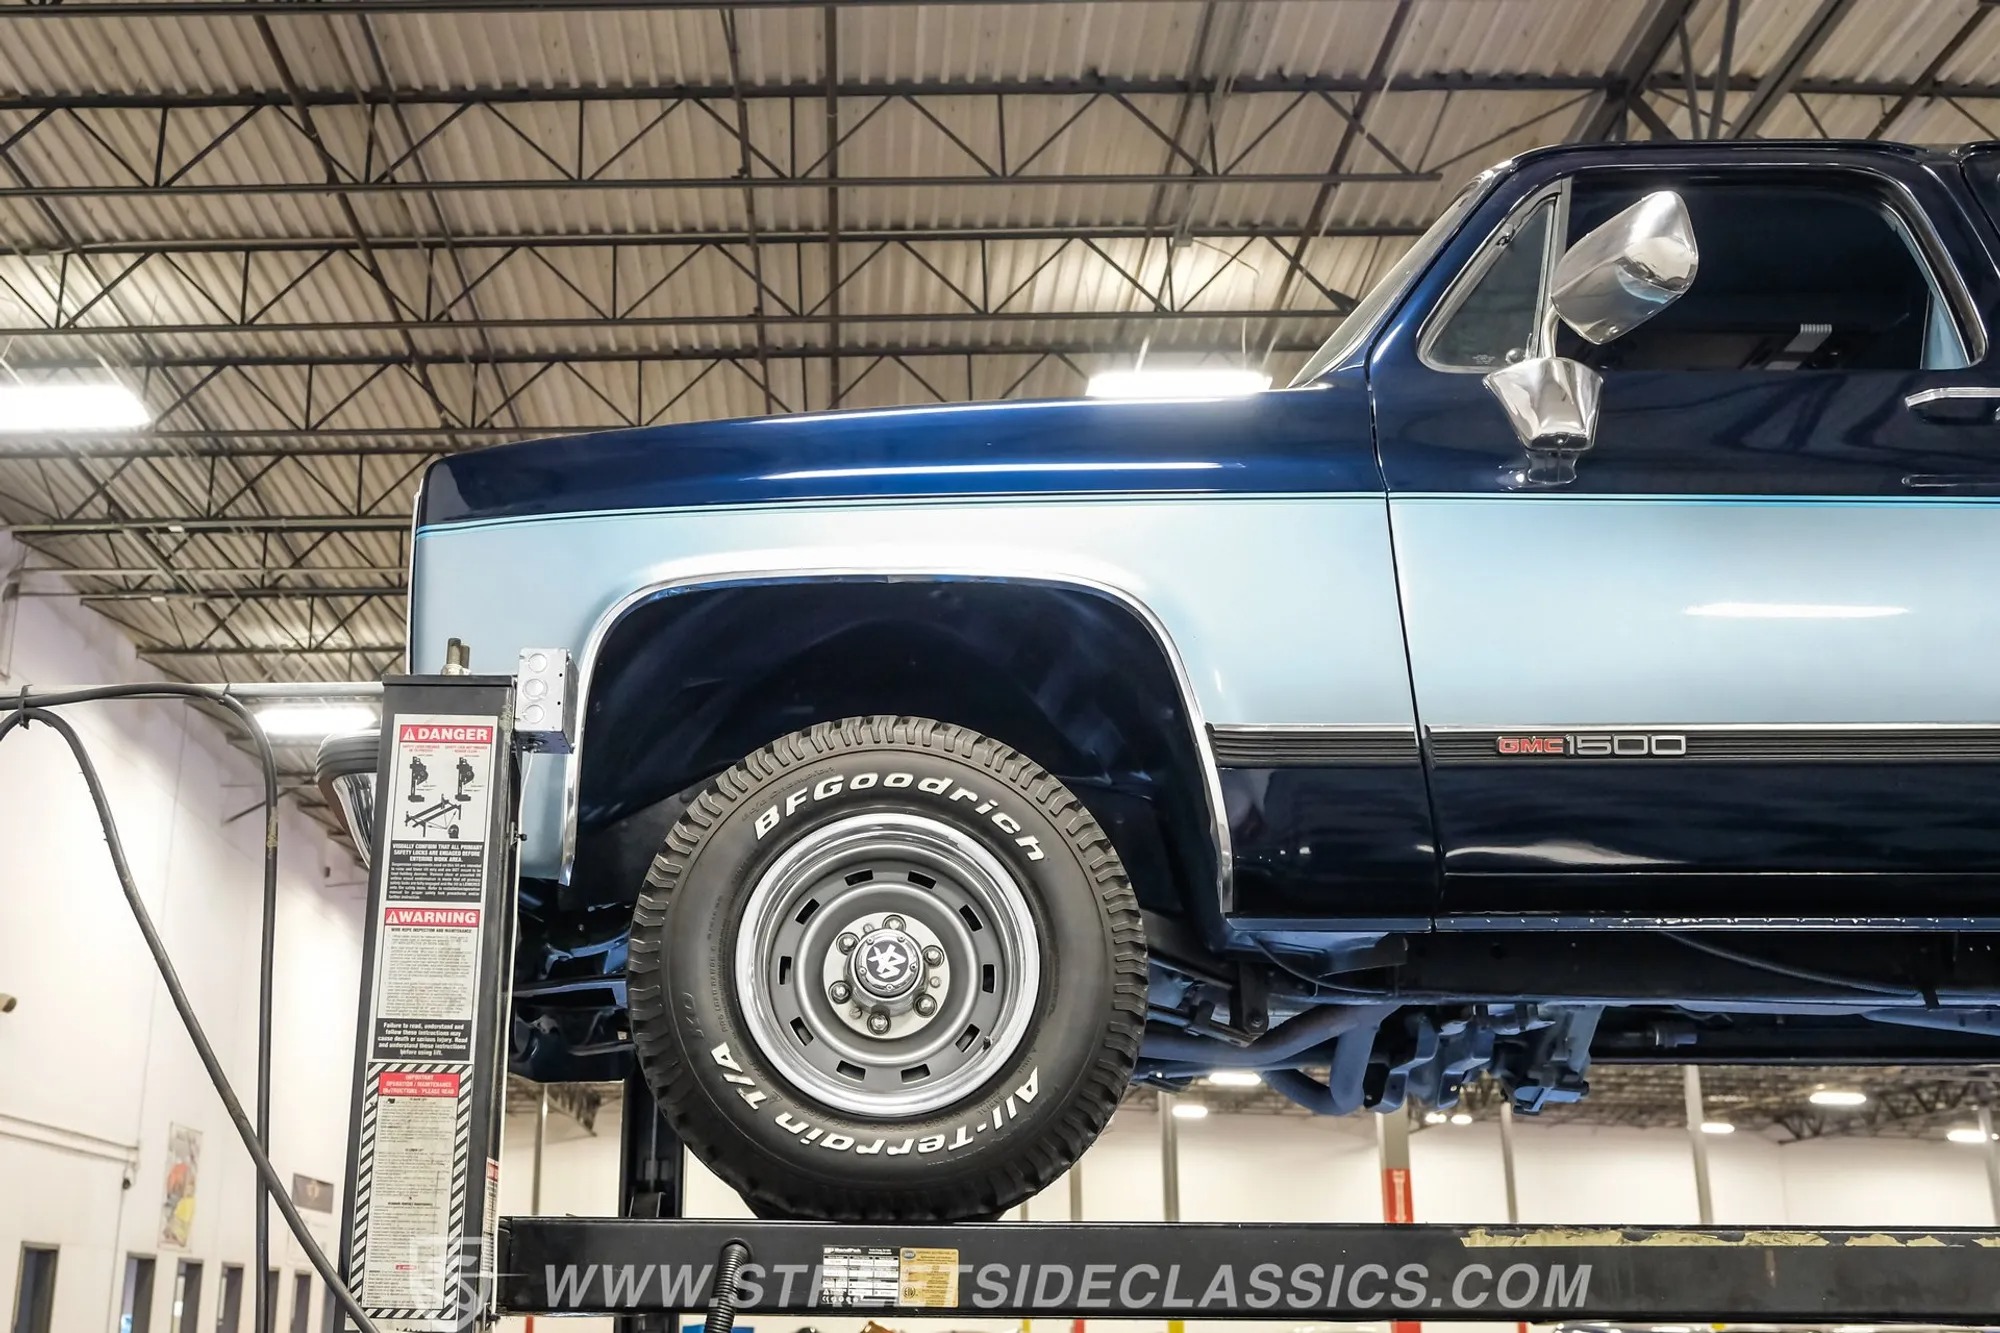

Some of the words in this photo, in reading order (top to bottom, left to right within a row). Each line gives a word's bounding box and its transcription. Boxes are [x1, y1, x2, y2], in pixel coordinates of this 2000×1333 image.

[418, 728, 487, 741] DANGER
[1498, 736, 1564, 754] GMC
[1566, 734, 1686, 756] 1500
[753, 772, 1046, 862] BFGoodrich
[399, 911, 476, 924] WARNING
[711, 1041, 768, 1111] T/A
[774, 1066, 1041, 1156] All-Terrain
